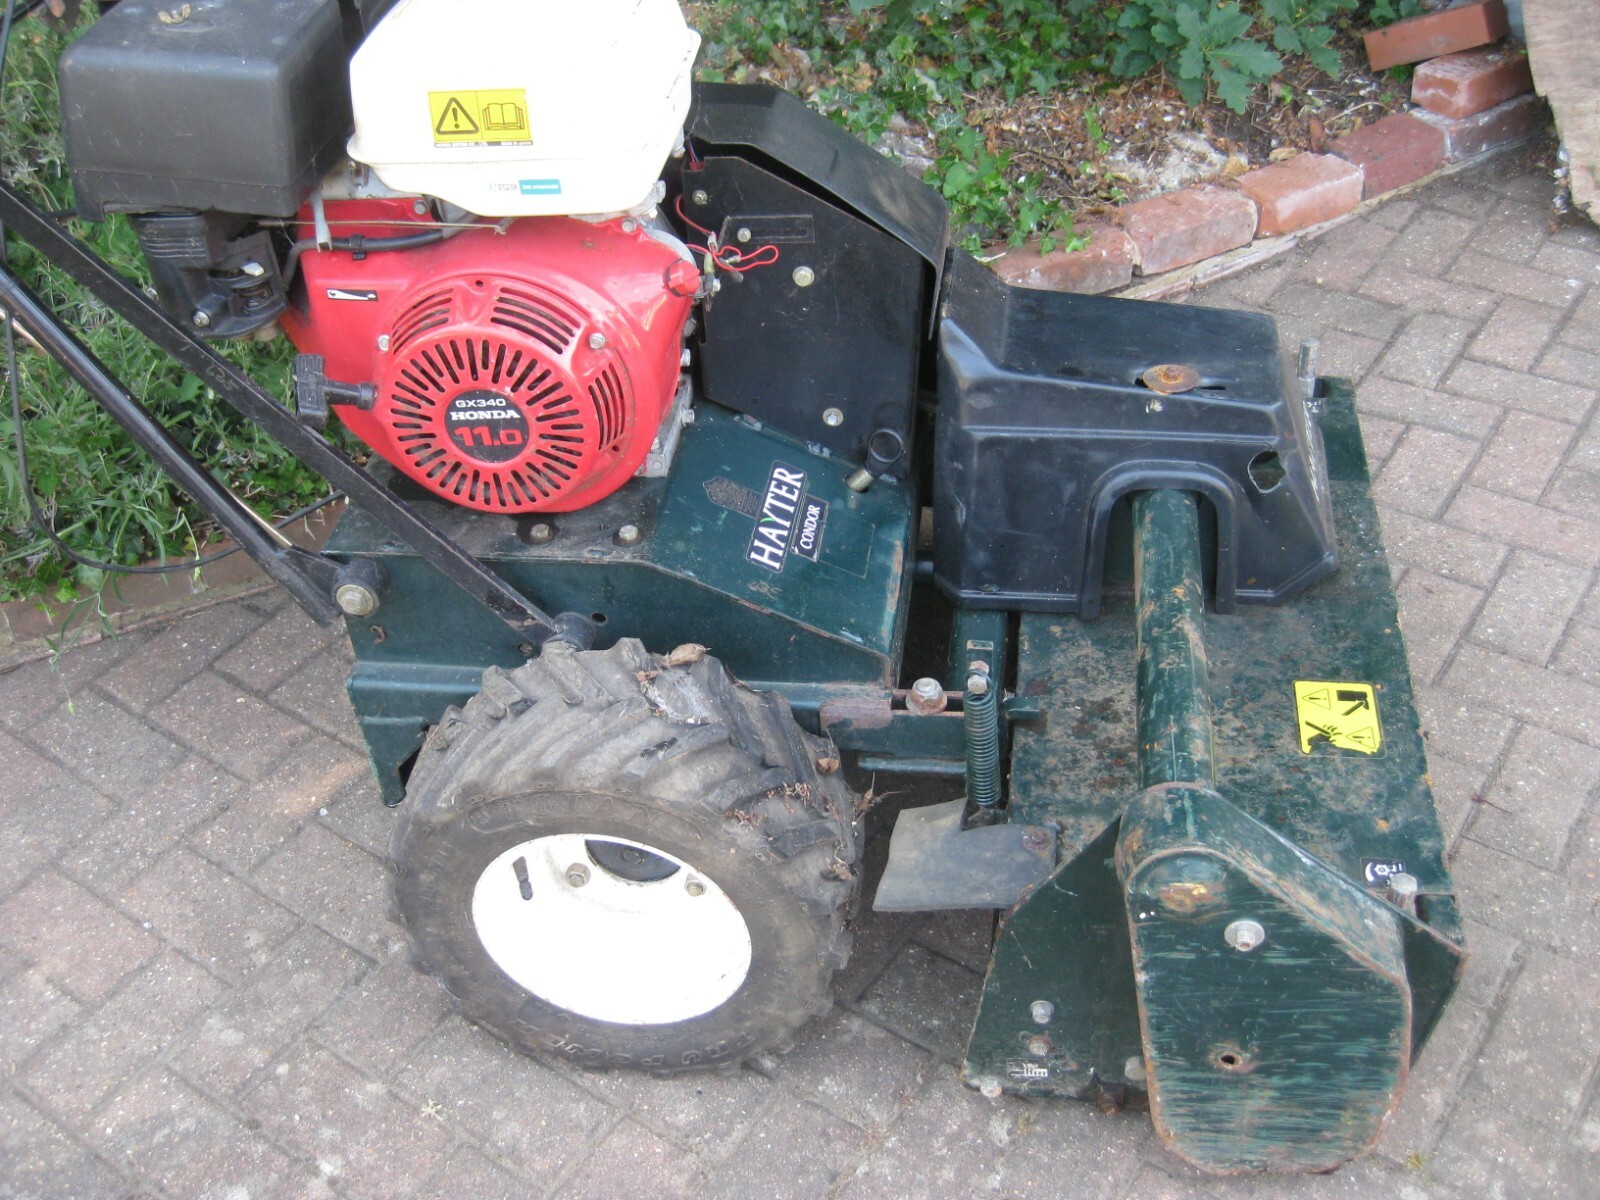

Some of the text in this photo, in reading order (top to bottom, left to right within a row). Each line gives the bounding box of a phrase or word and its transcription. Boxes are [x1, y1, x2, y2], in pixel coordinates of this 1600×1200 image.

[456, 399, 506, 407] GX340
[450, 410, 520, 420] HONDA
[455, 426, 522, 446] 11.0
[750, 467, 804, 570] HAYTER
[799, 504, 821, 550] CONDOR
